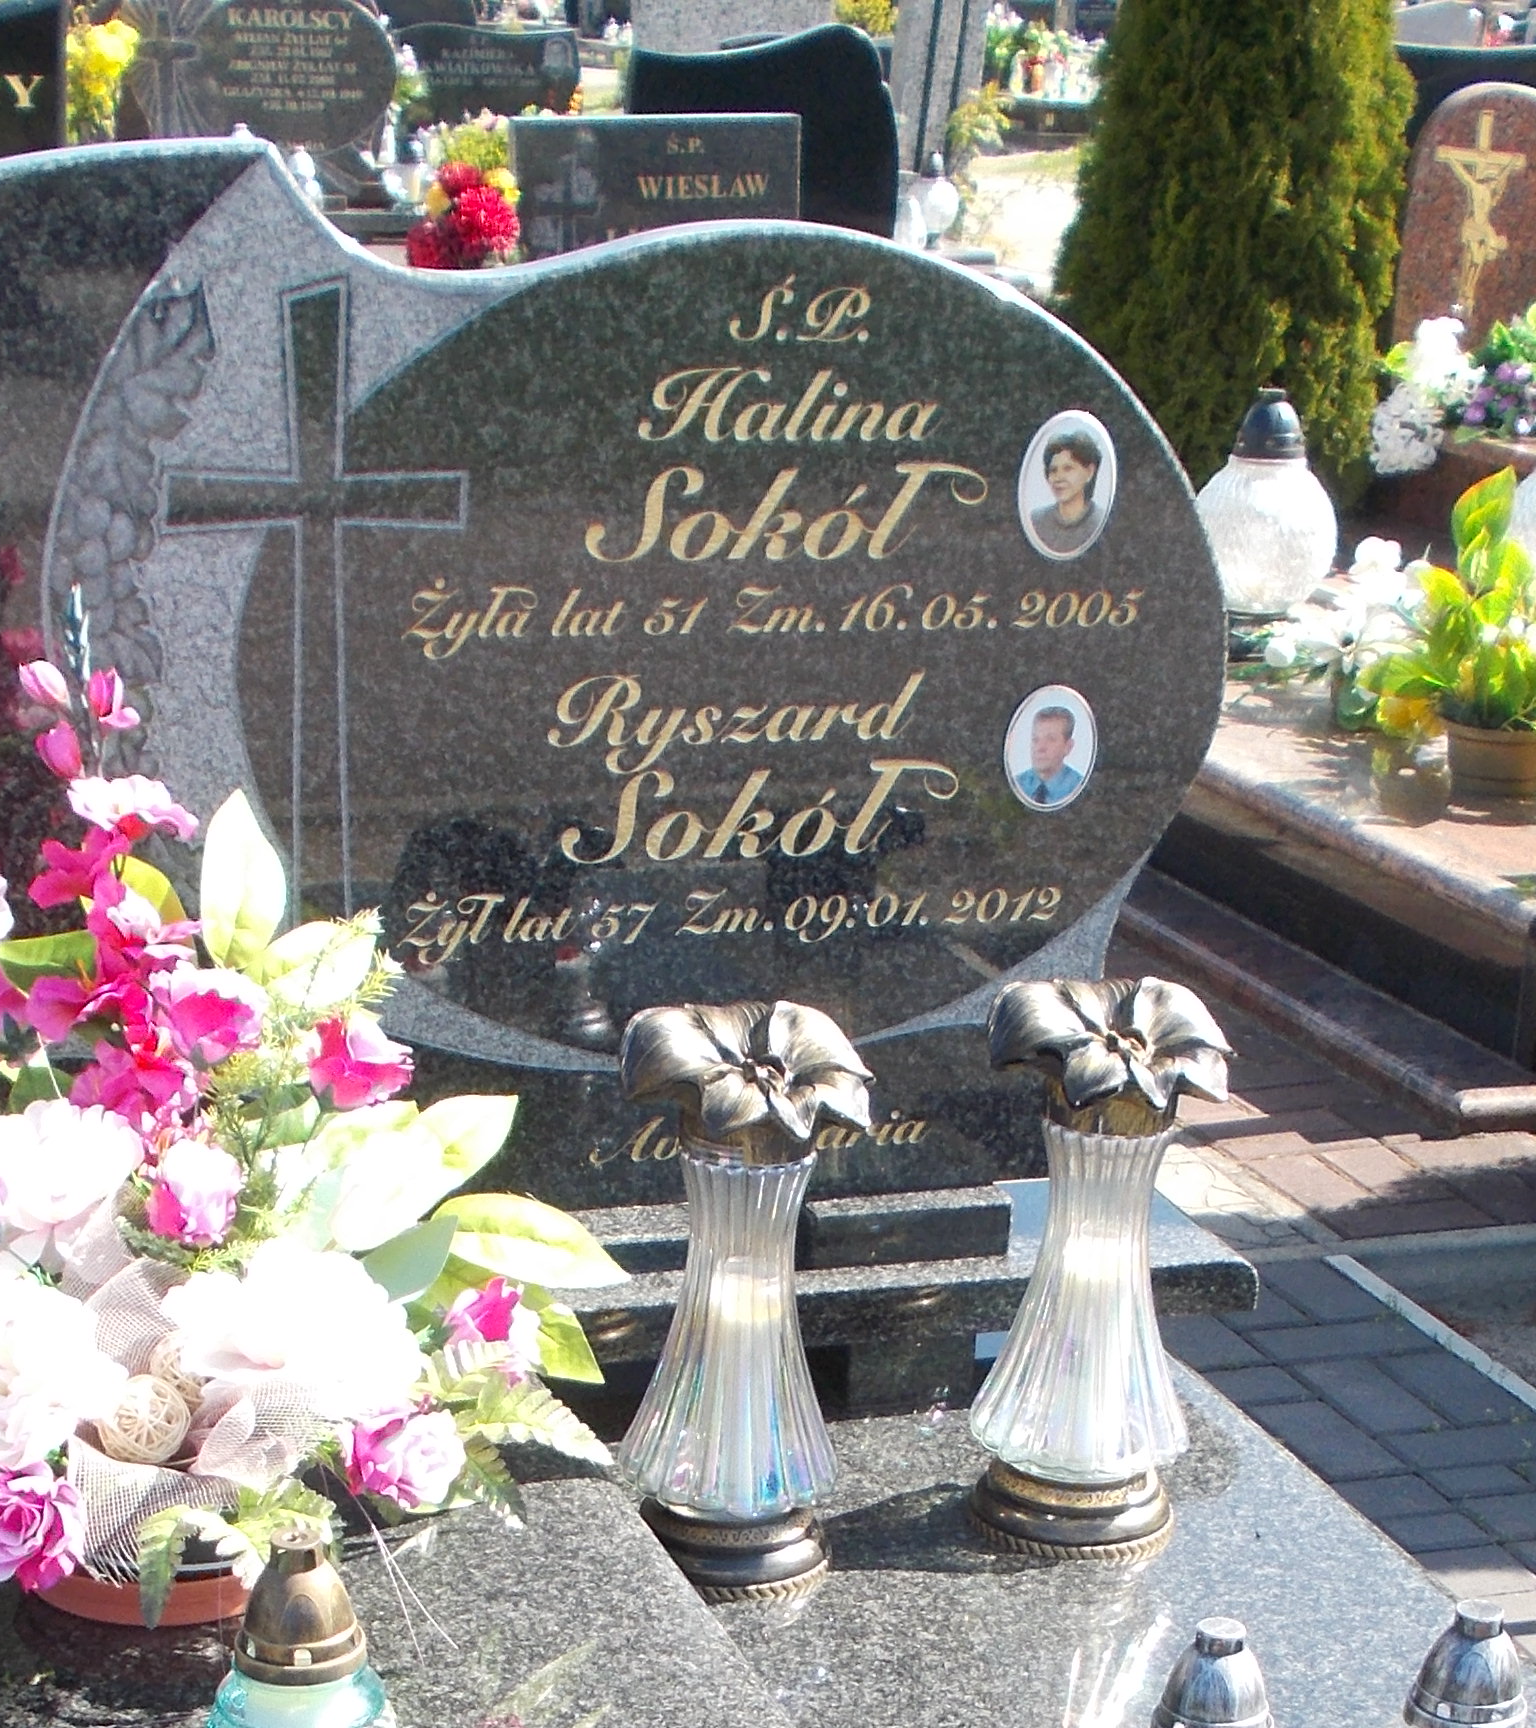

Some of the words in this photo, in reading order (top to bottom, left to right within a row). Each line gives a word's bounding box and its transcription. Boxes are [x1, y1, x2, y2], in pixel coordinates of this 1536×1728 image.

[228, 9, 352, 30] KAROLSCY
[638, 174, 769, 200] WIESŁAW
[729, 275, 870, 344] Ś.P.
[638, 366, 942, 444] Halina
[585, 461, 989, 562] Sokół
[401, 577, 539, 662] Żyła
[551, 587, 626, 637] lat
[644, 597, 709, 635] 51
[547, 671, 926, 775] Ryszard
[562, 758, 960, 865] Sokół
[396, 891, 505, 966] Żył
[503, 896, 573, 943] lat
[591, 905, 661, 945] 57
[811, 1109, 927, 1150] aria
